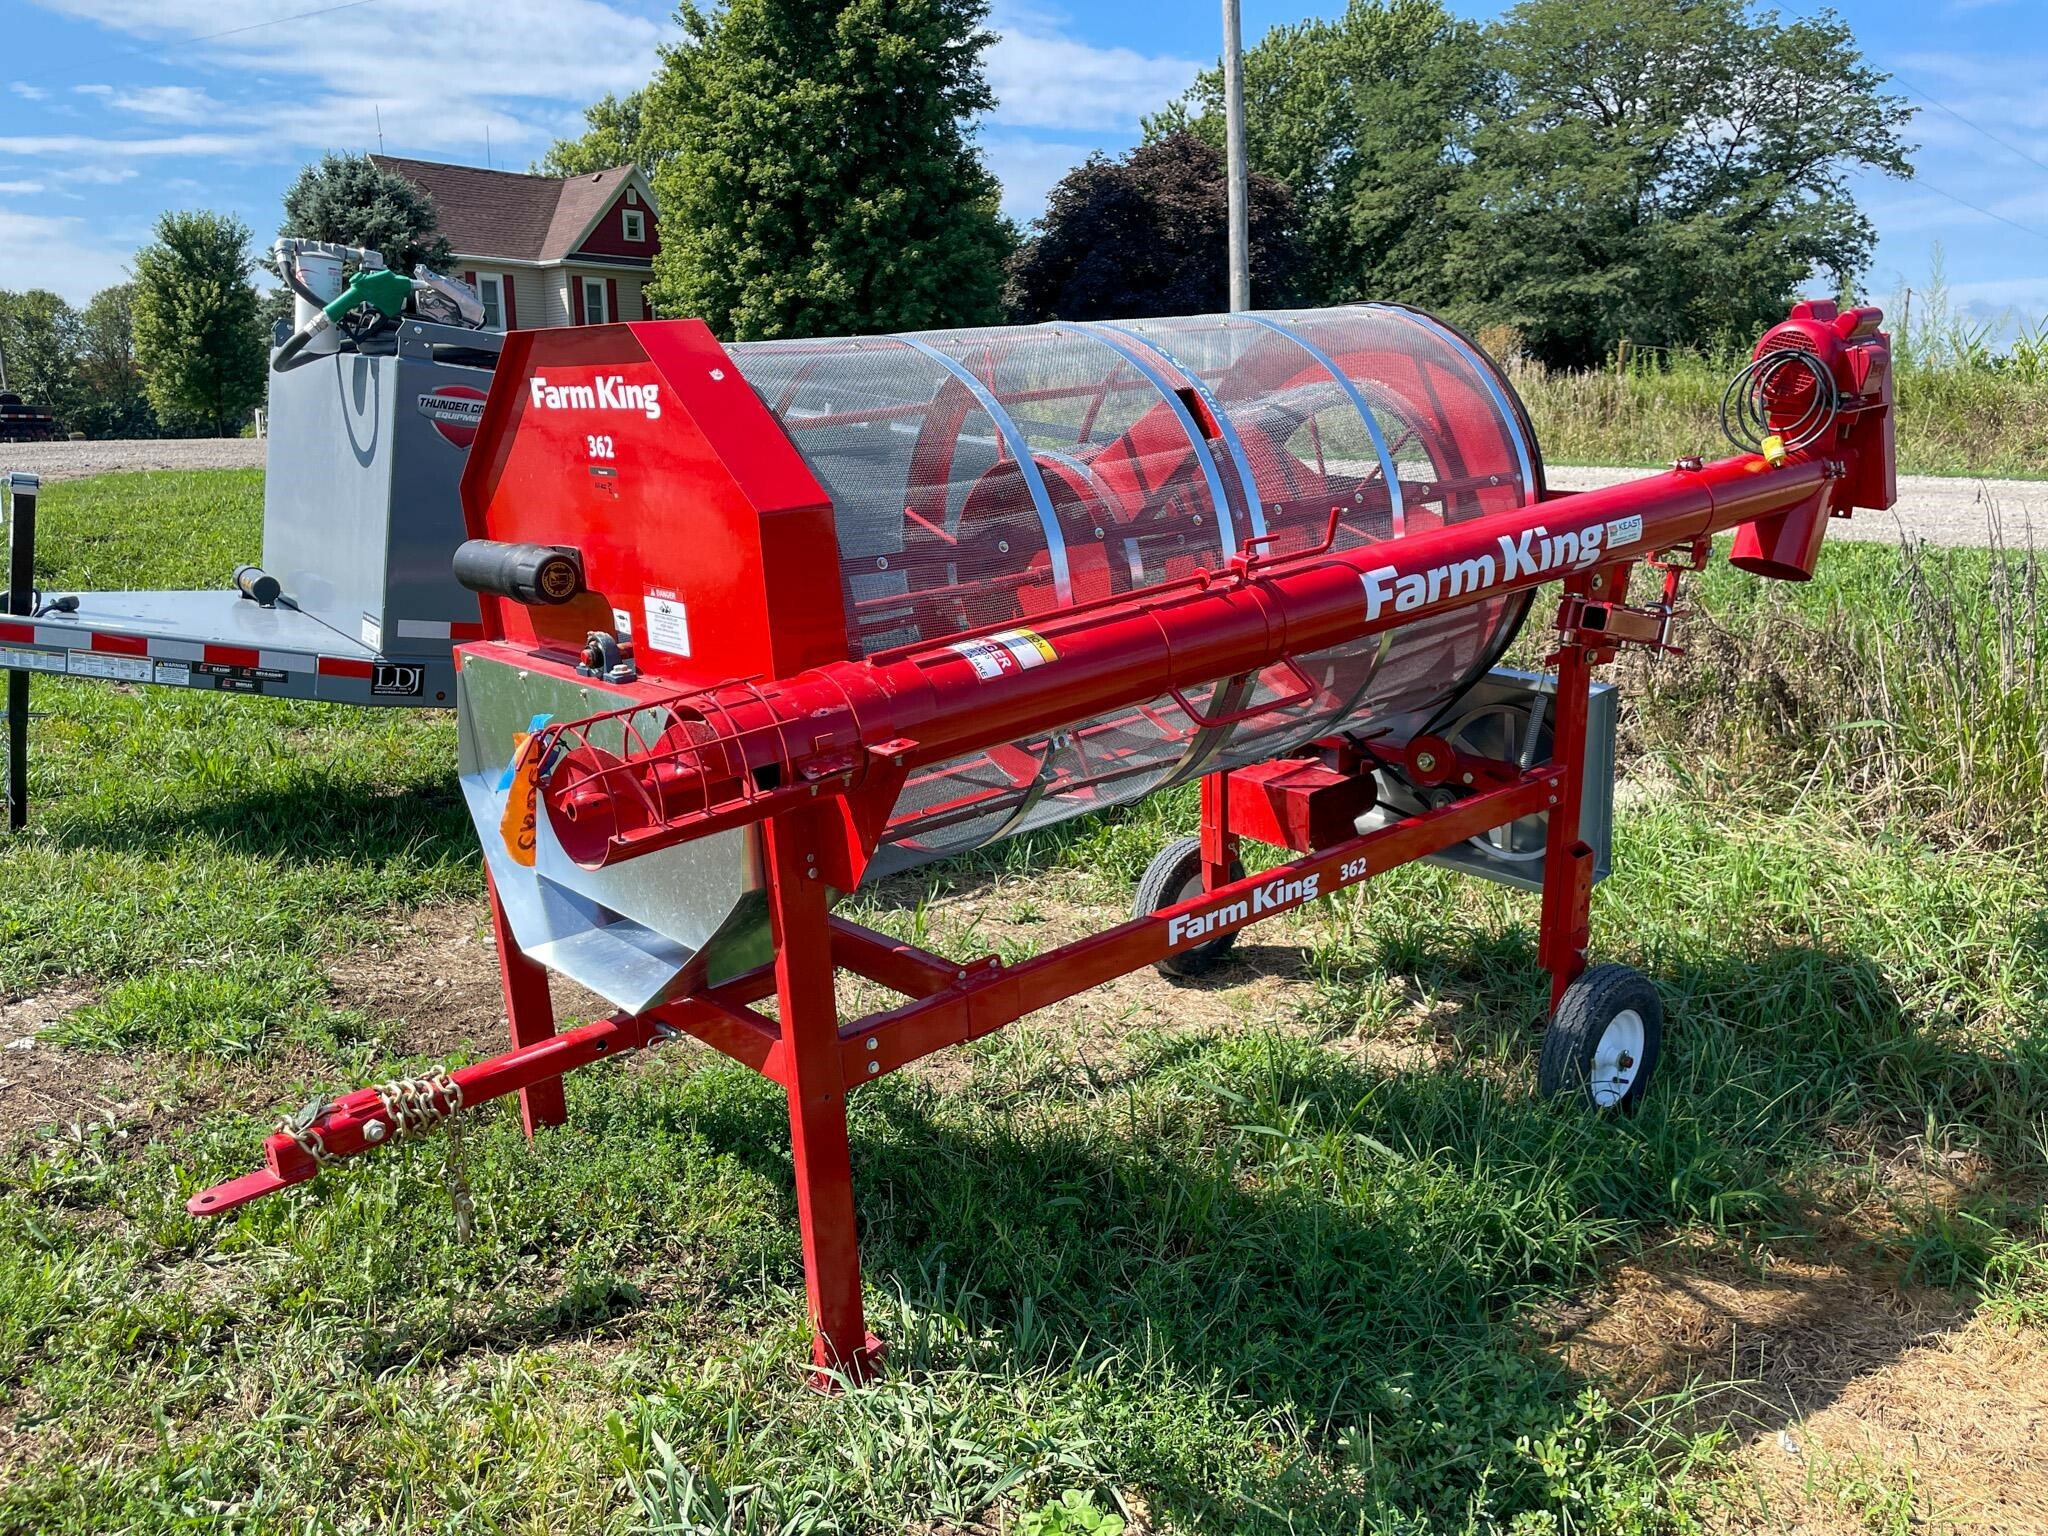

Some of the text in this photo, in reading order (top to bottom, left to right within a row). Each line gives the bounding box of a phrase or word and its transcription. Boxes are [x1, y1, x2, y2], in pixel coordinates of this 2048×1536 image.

[420, 398, 470, 413] THUNDER
[530, 375, 661, 419] Farm King
[587, 435, 615, 458] 362
[1618, 518, 1641, 530] KEAST
[1359, 523, 1604, 622] Farm King
[656, 588, 676, 600] DANGER
[977, 639, 1012, 669] NGER
[375, 667, 423, 694] LDJ
[1168, 857, 1367, 946] Farm King 362
